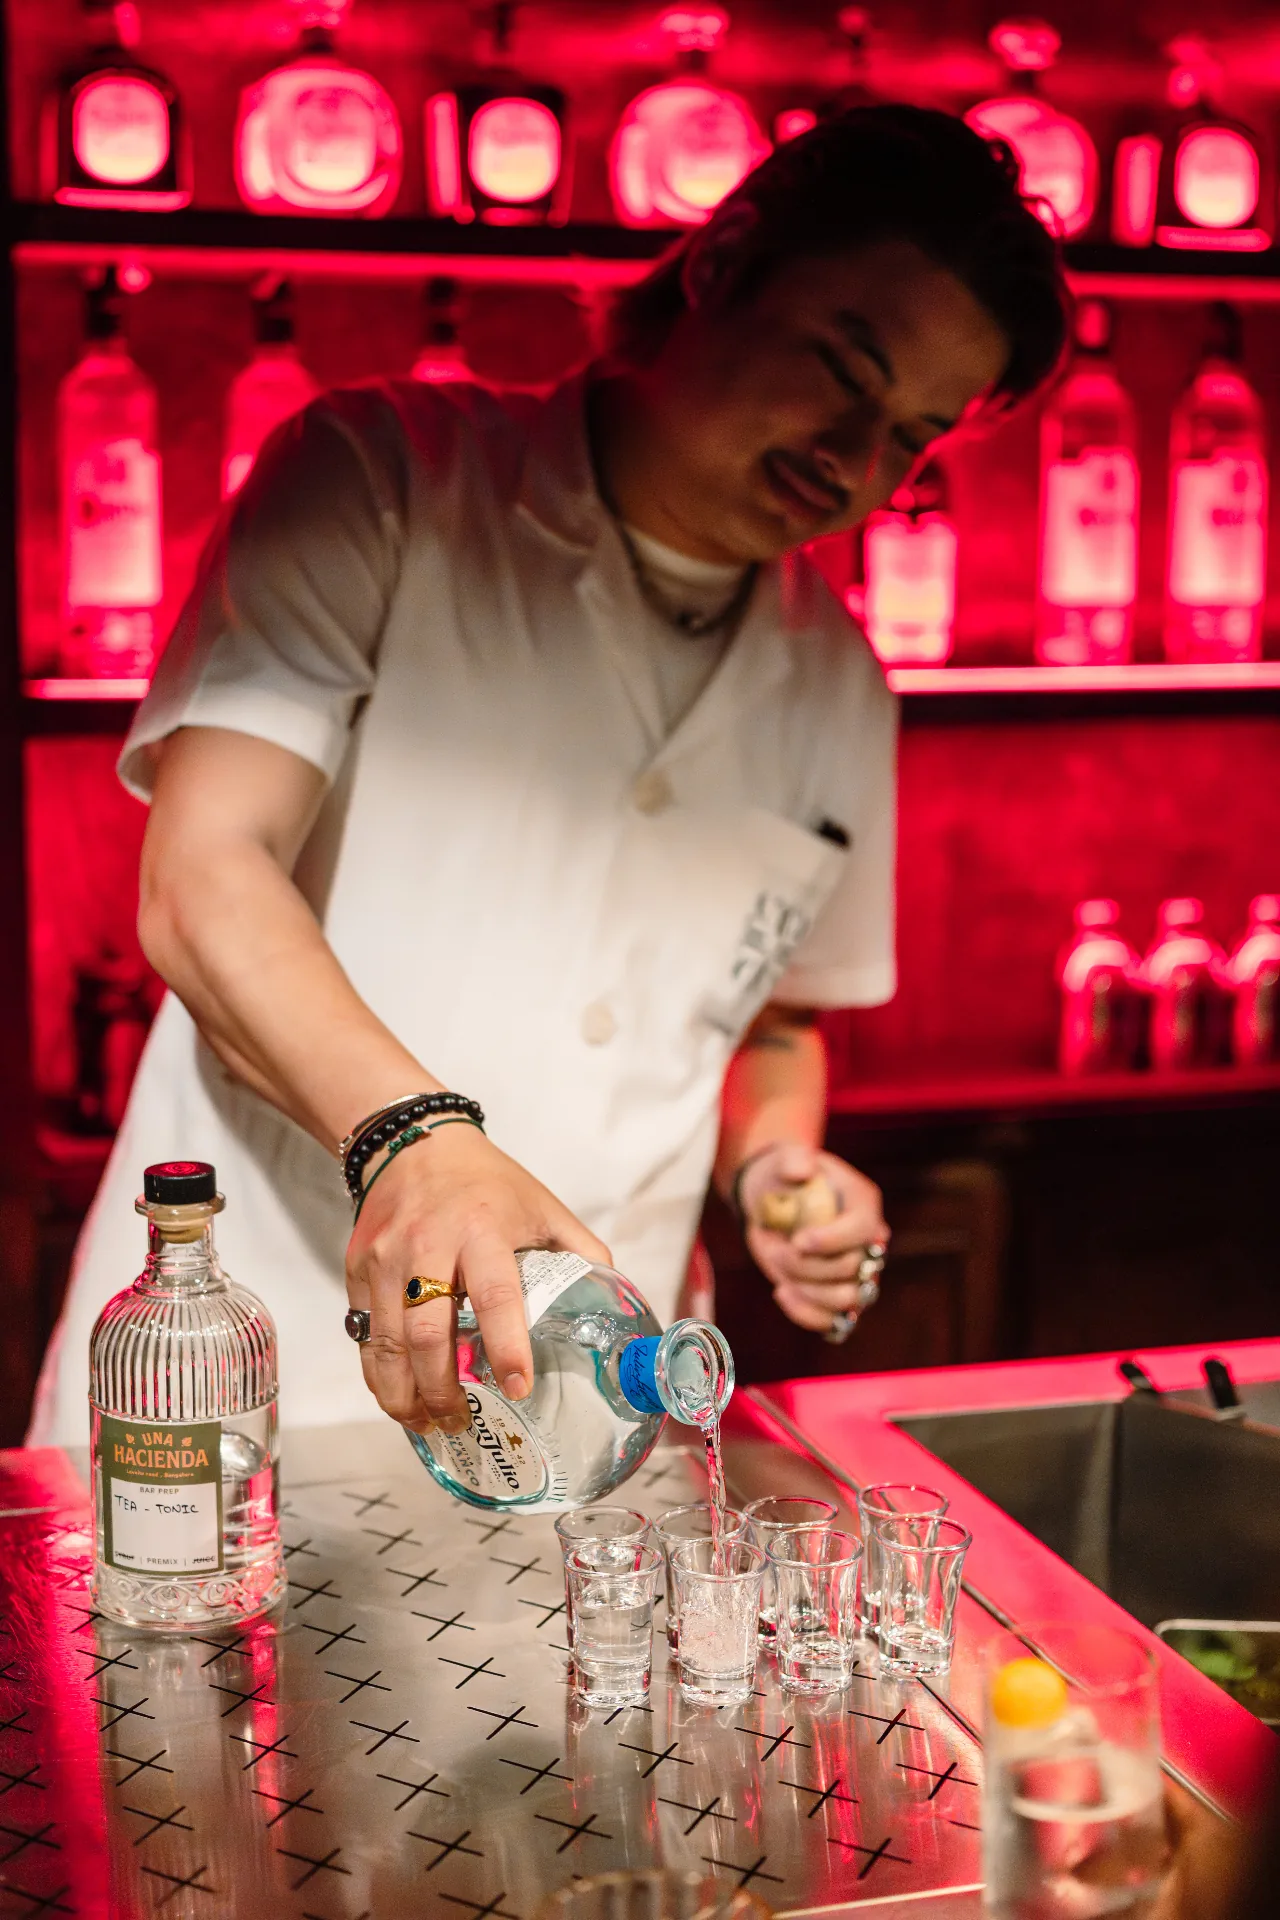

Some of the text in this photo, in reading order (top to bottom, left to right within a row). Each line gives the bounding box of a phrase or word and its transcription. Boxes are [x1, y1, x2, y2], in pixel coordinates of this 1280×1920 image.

[141, 1431, 173, 1447] UNA
[113, 1443, 210, 1469] HACIENDA
[455, 1436, 474, 1466] EQUILA
[114, 1494, 138, 1512] TEA
[155, 1503, 199, 1514] TONIC
[146, 1557, 178, 1565] PREMIX
